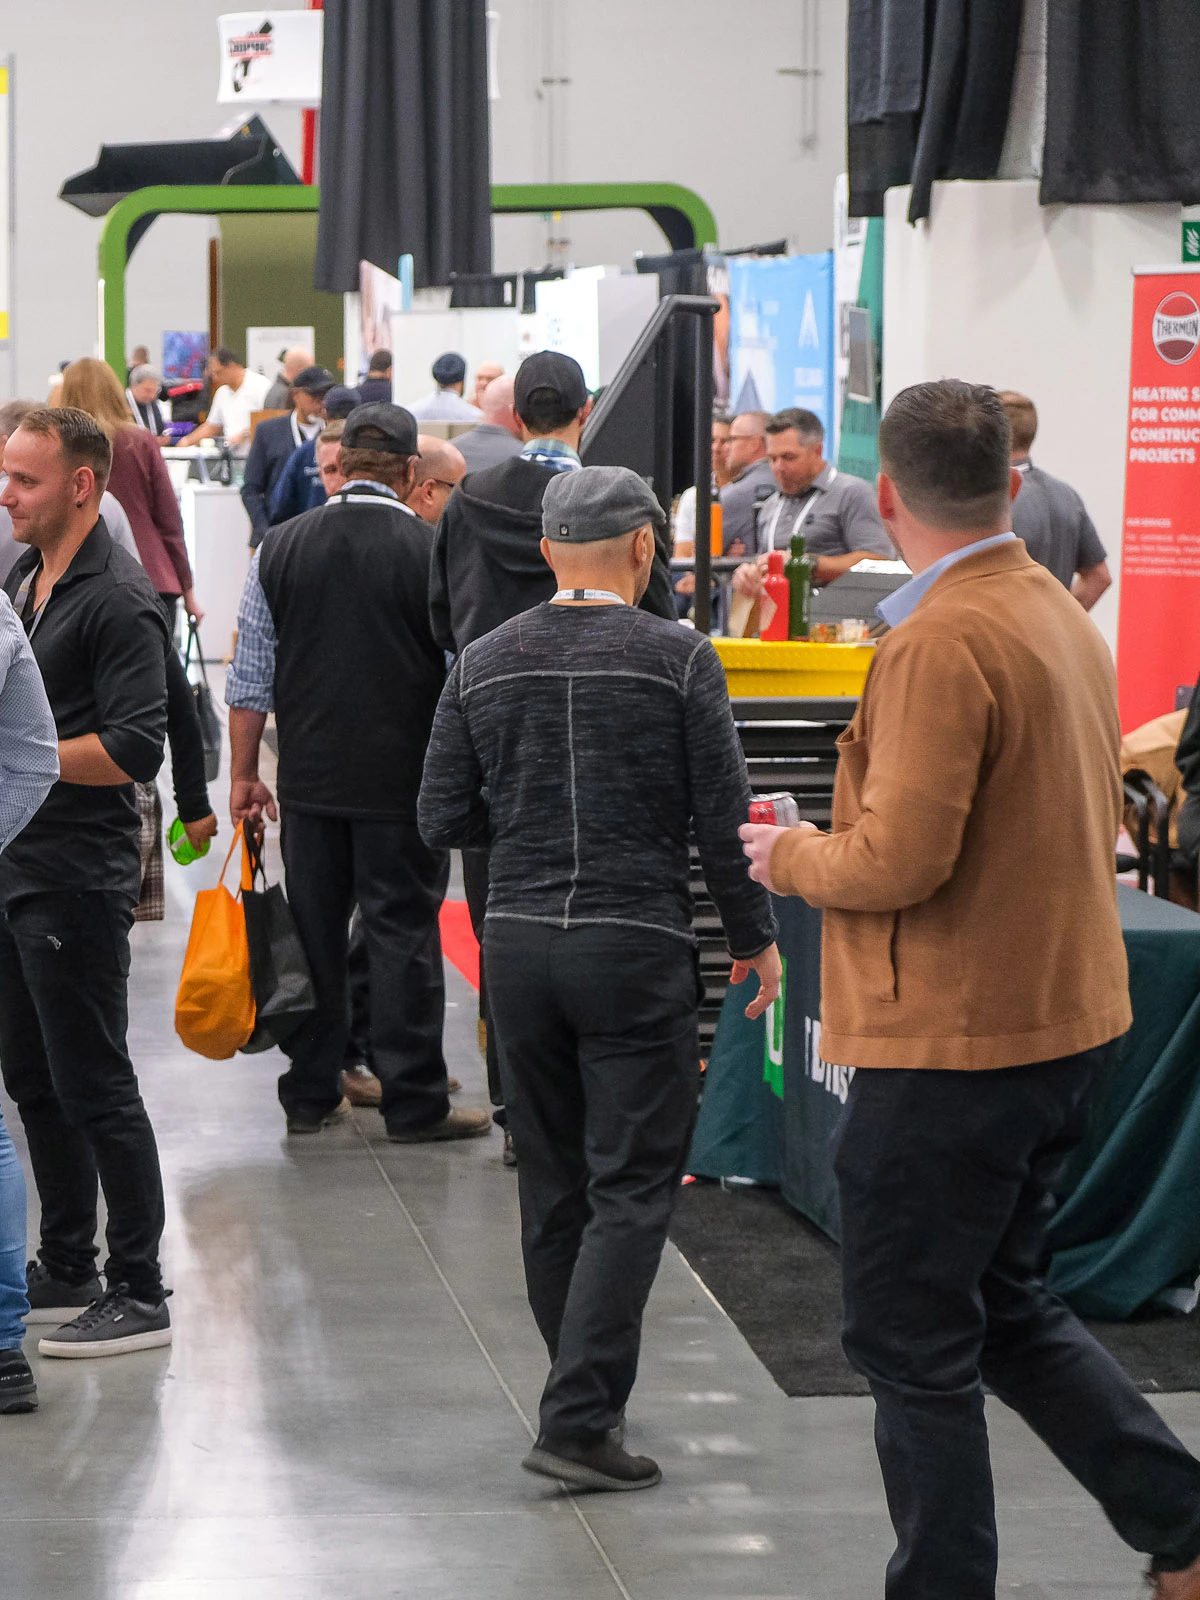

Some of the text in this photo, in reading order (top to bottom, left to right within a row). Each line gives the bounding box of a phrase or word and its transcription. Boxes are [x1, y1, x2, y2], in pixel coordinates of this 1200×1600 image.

[1157, 319, 1198, 337] THERMON
[1132, 387, 1189, 402] HEATING
[1131, 407, 1158, 422] FOR
[1129, 447, 1196, 463] PROJECTS
